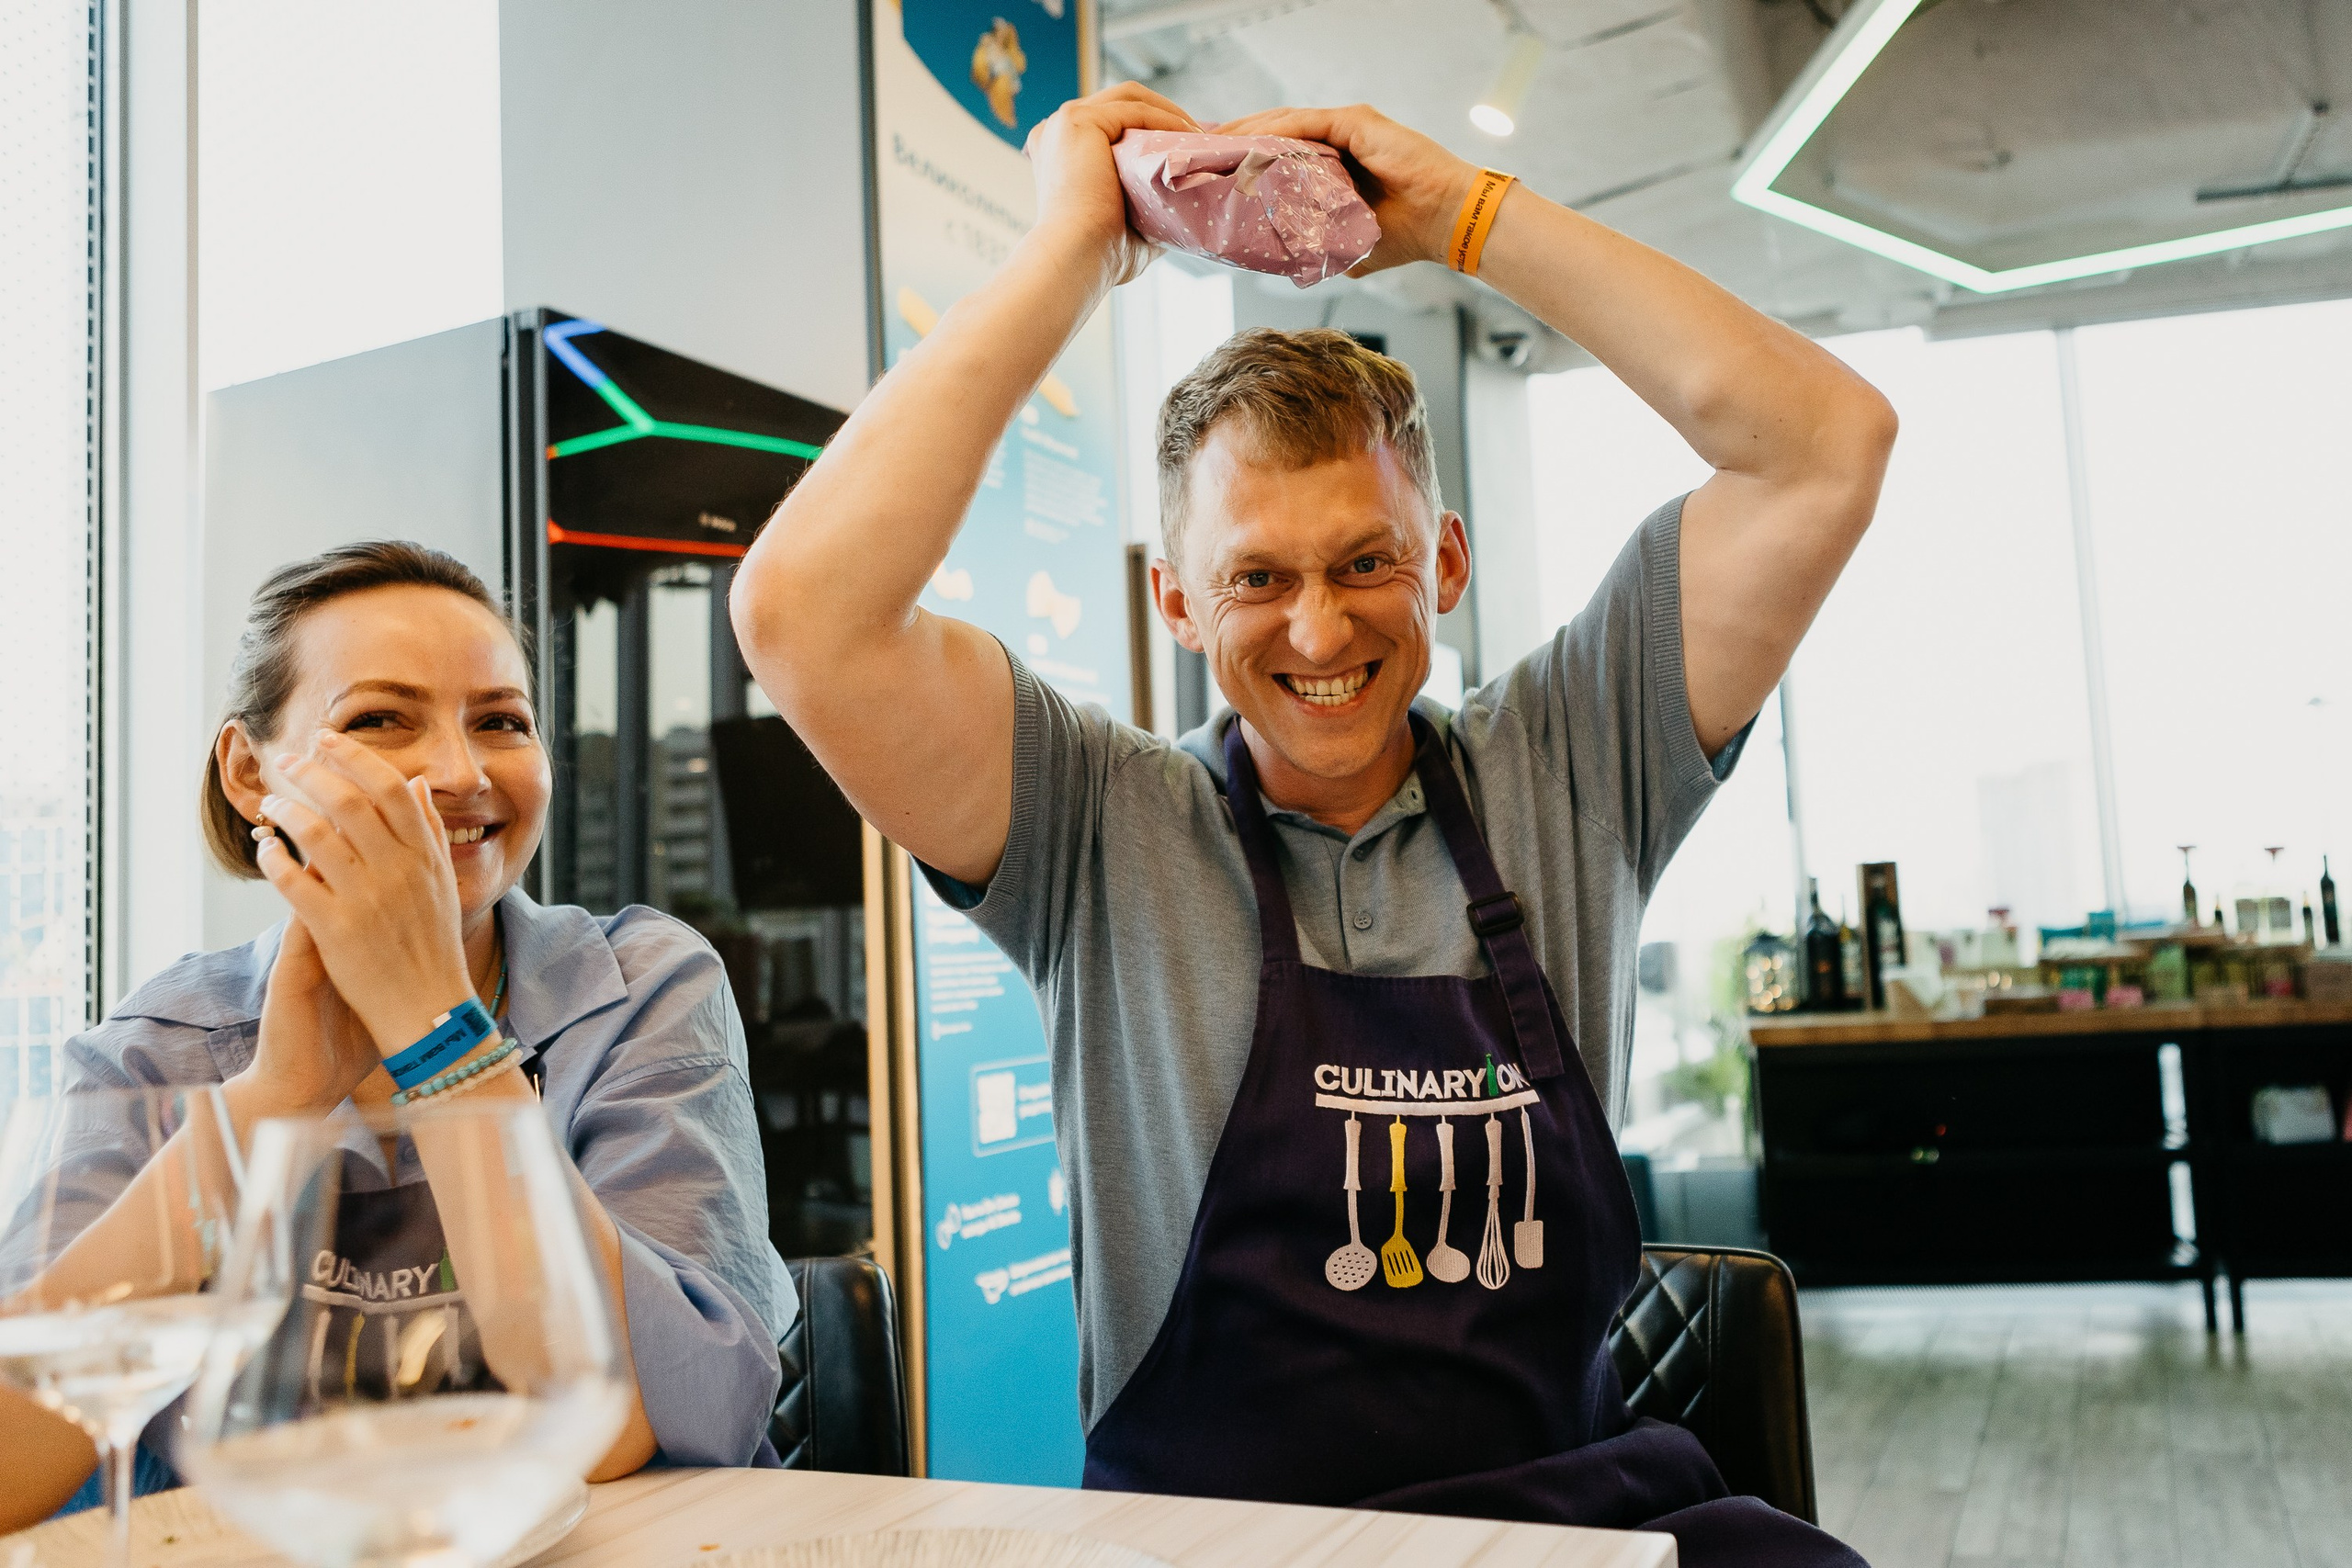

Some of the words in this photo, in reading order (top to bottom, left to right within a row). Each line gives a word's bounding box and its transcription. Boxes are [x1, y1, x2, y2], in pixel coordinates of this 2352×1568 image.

[1481, 180, 1496, 198] Мы
[1472, 197, 1486, 220] вам
[1462, 221, 1476, 250] такое
[1314, 1064, 1487, 1100] CULINARY
